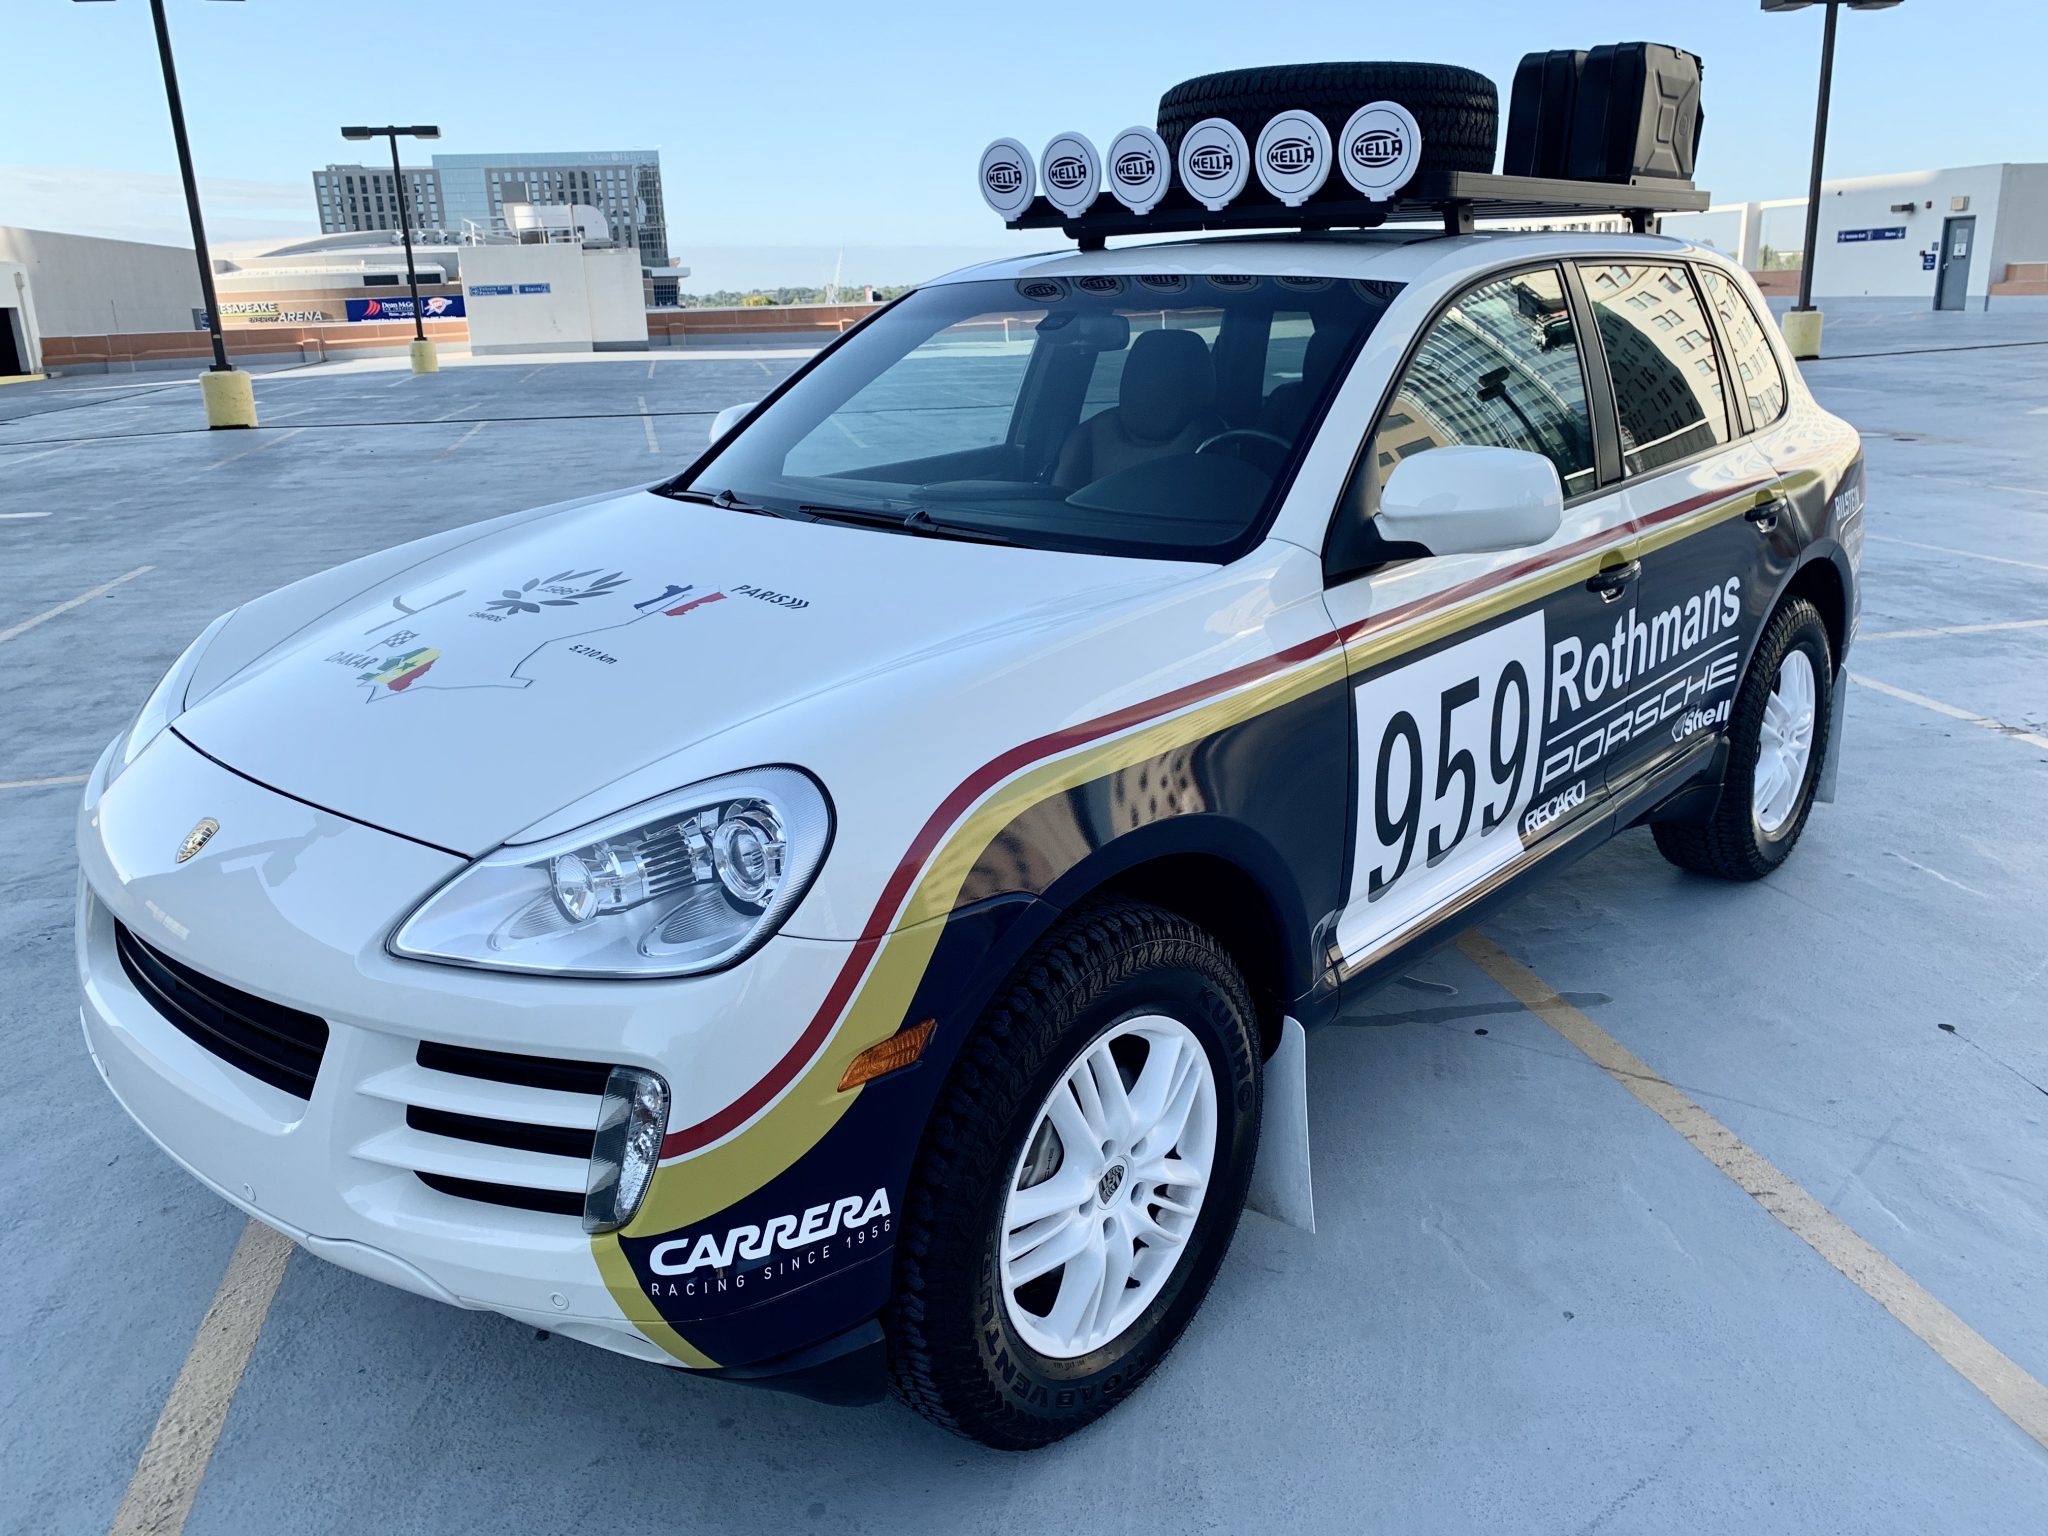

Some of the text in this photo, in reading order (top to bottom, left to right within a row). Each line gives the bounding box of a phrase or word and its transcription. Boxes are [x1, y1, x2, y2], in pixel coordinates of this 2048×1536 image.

[1271, 147, 1314, 164] HELLA
[1356, 140, 1403, 157] HELLA
[1052, 165, 1086, 179] HELLA
[1117, 162, 1155, 176] HELLA
[1192, 155, 1233, 170] HELLA
[989, 171, 1022, 185] HELLA
[218, 303, 275, 314] ESAPEAKE
[279, 311, 323, 323] ARENA
[1835, 485, 1860, 521] BILSTEIN
[730, 584, 790, 603] PARIS
[595, 653, 618, 665] km
[1549, 576, 1741, 723] Rothmans
[325, 650, 378, 670] DAKAR
[1539, 651, 1739, 794] PORSCHE
[1684, 699, 1731, 737] Shell
[1368, 659, 1531, 904] 959
[1524, 779, 1586, 837] RECARO
[649, 1186, 892, 1276] CARRERA
[651, 1219, 891, 1297] RACING SINCE 1956
